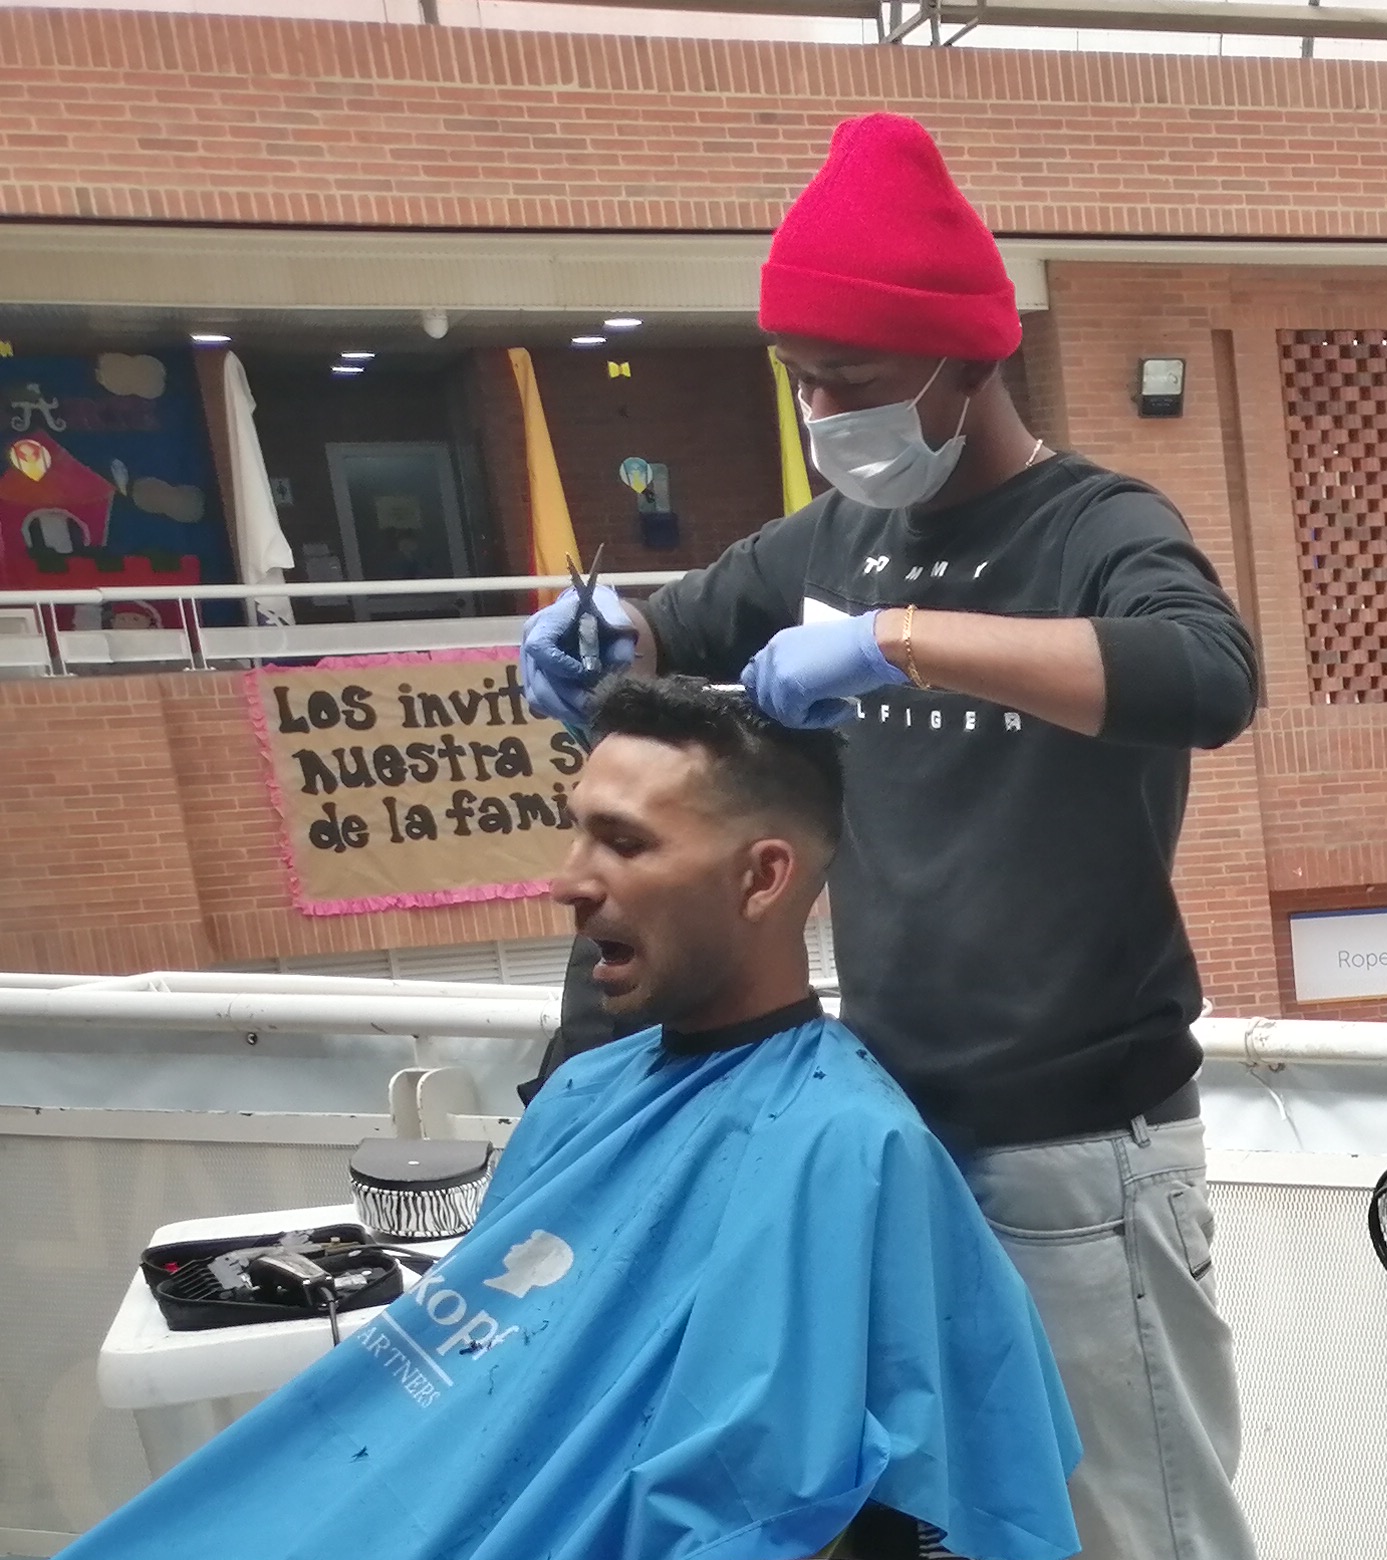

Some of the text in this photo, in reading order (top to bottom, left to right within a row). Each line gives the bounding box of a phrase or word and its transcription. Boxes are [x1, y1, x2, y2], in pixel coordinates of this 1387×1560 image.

[863, 555, 990, 582] TOMMY
[292, 734, 534, 796] nuestra
[309, 781, 580, 854] de la fami
